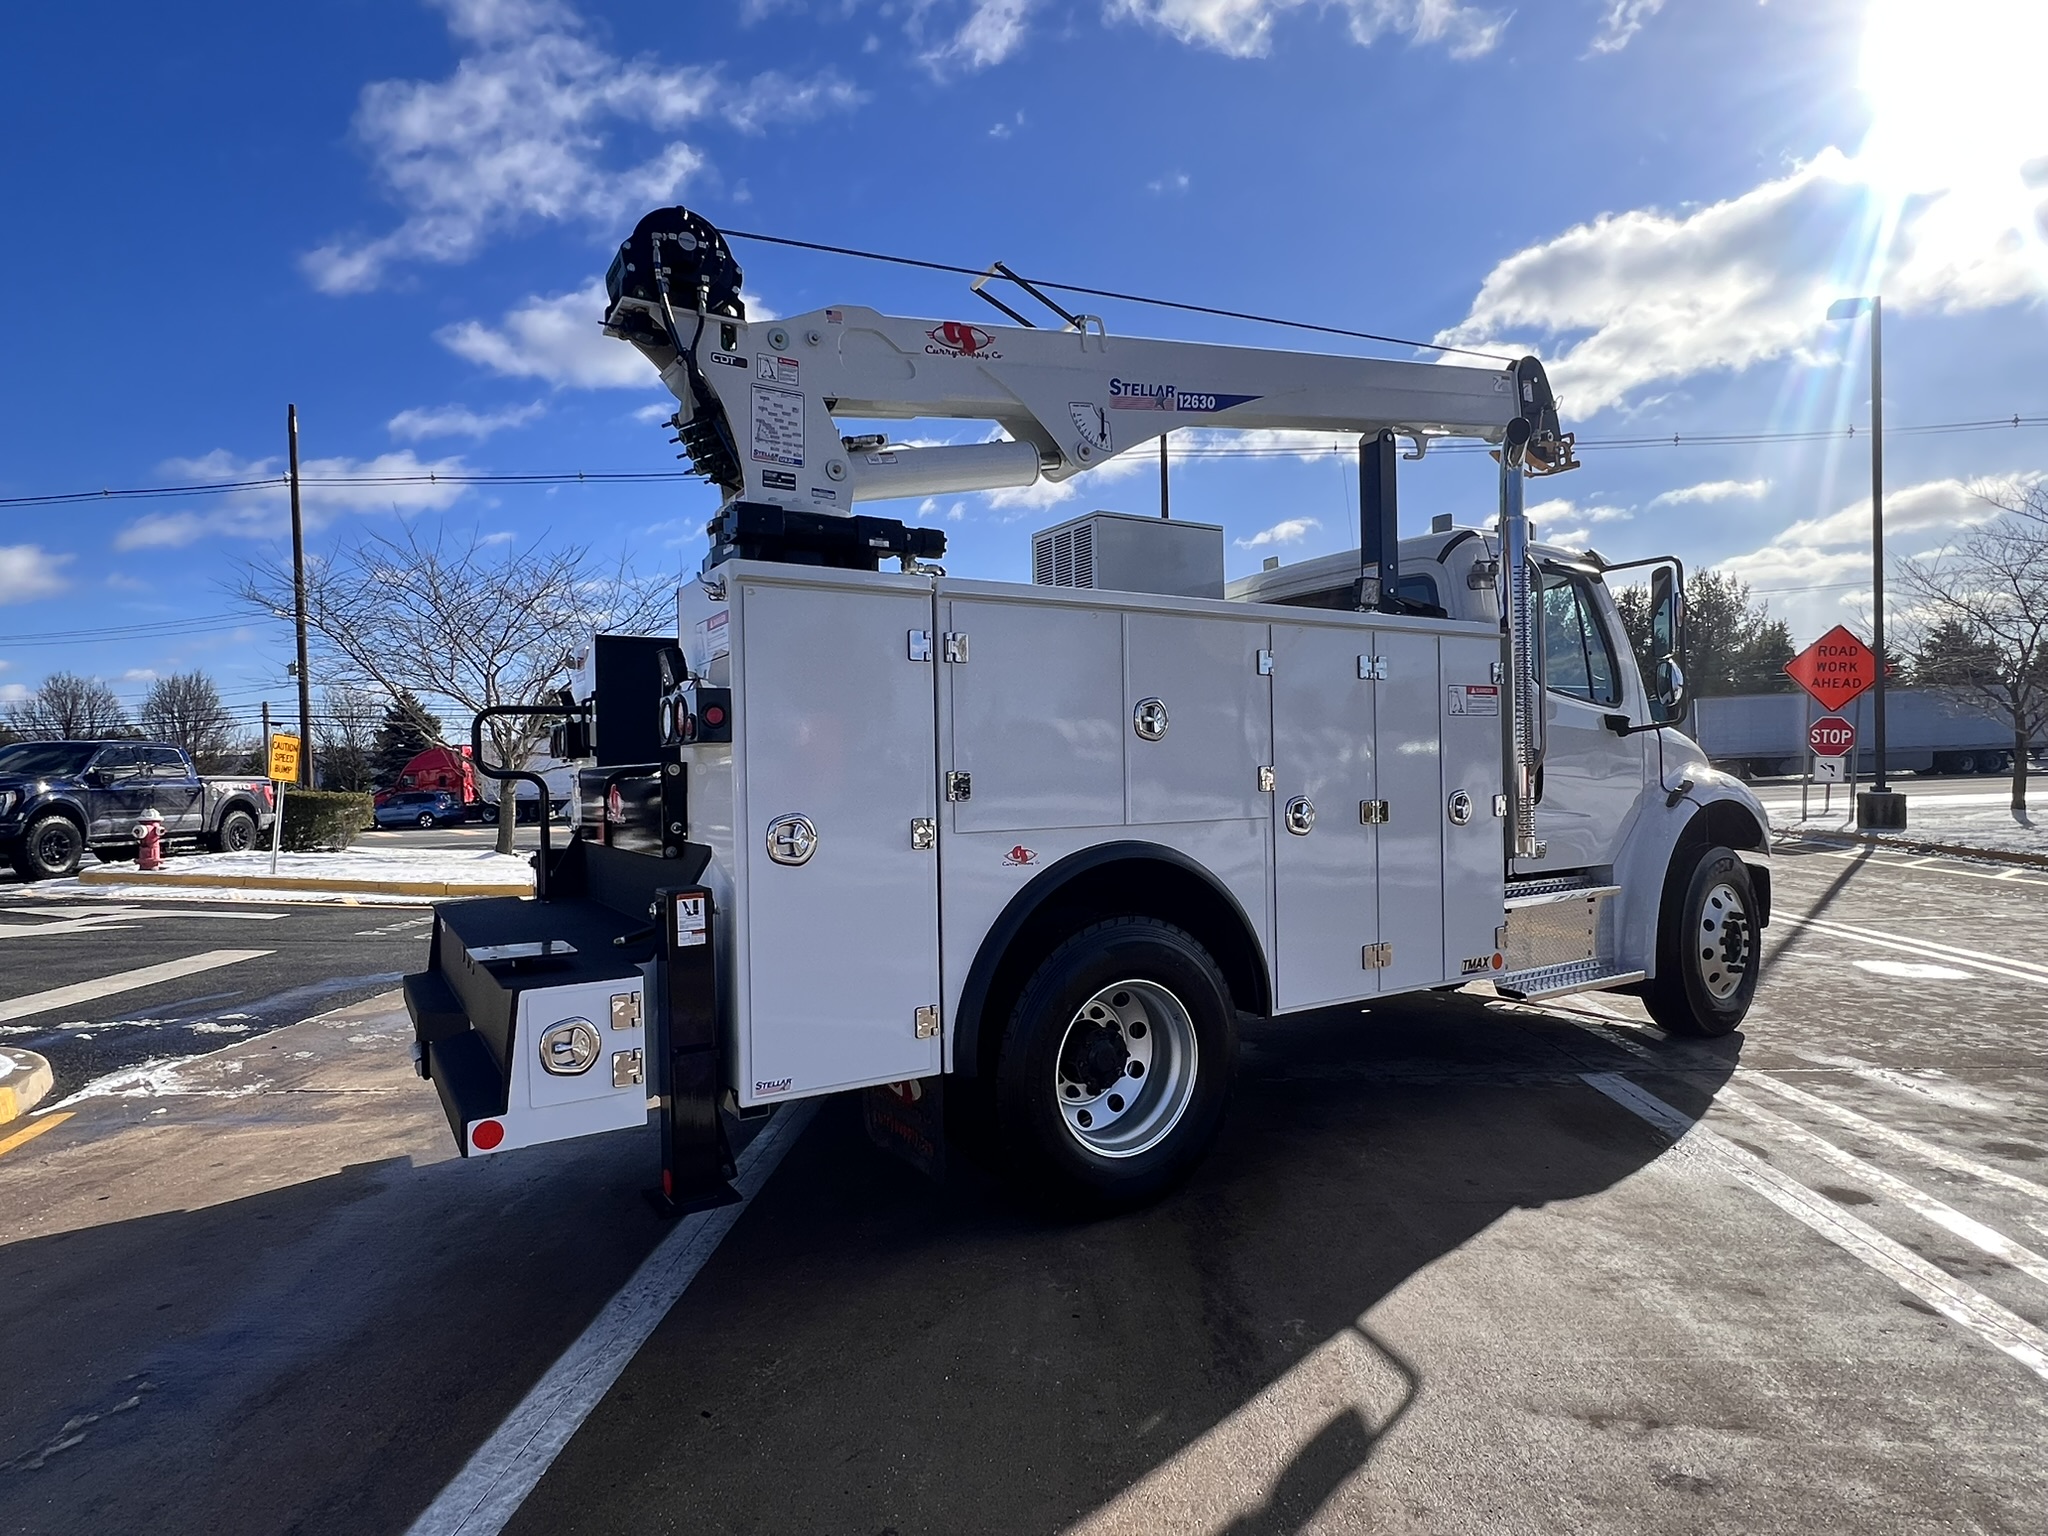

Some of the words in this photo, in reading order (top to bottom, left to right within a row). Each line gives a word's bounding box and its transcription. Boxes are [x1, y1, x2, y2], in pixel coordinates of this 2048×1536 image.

[925, 345, 957, 358] Curry
[712, 354, 736, 365] CDT
[1109, 378, 1175, 398] STELLAR
[1178, 394, 1216, 409] 12630
[1818, 645, 1858, 657] ROAD
[1817, 661, 1858, 673] WORK
[1811, 677, 1862, 689] AHEAD
[1810, 729, 1852, 744] STOP
[273, 741, 298, 752] CAUTION
[274, 753, 295, 764] SPEED
[274, 764, 293, 774] BUMP
[1463, 956, 1491, 970] TMAX
[756, 1078, 793, 1091] STELLAR
